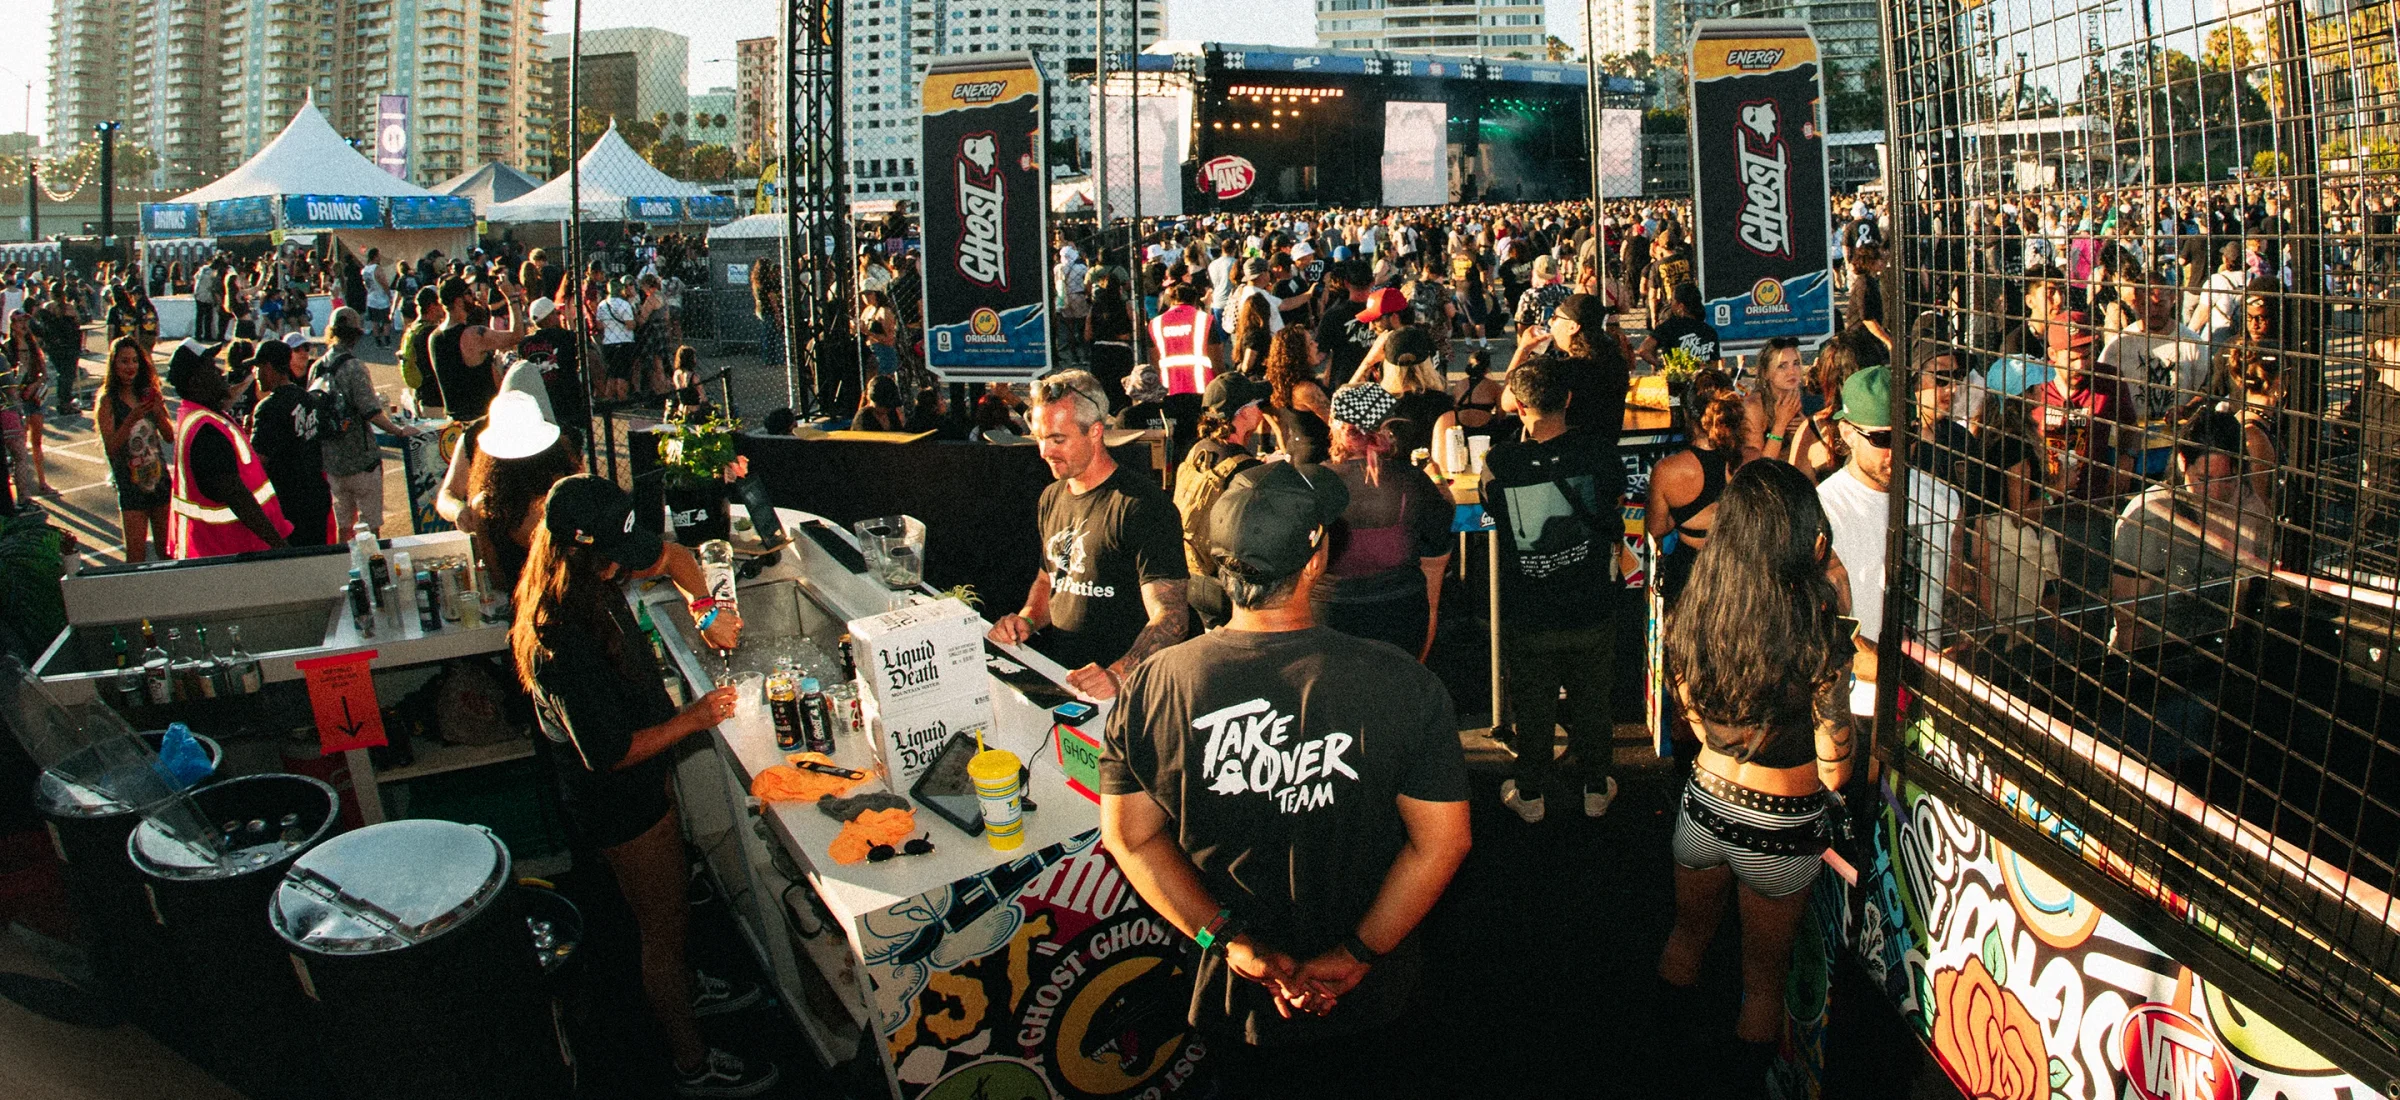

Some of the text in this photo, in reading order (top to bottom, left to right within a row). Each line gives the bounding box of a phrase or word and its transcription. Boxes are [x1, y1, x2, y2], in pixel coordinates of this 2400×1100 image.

[1727, 49, 1784, 66] ENERGY
[952, 81, 1007, 99] ENERGY
[1204, 160, 1248, 193] VANS
[1738, 128, 1791, 257] GHOST
[154, 210, 187, 230] DRINKS
[307, 202, 363, 221] DRINKS
[640, 201, 673, 216] DRINKS
[959, 159, 1007, 287] GHOST
[1745, 305, 1790, 315] ORIGINAL
[964, 334, 1007, 343] ORIGINAL
[1679, 333, 1701, 352] TAKE
[1691, 341, 1715, 357] OVER
[879, 639, 936, 671] Liquid
[888, 661, 940, 691] Death
[891, 682, 940, 698] MOUNTAIN WATER
[891, 719, 947, 751] Liquid
[1191, 698, 1294, 779] TAKE
[1250, 732, 1360, 801] OVER
[1275, 782, 1334, 814] TEAM
[1017, 950, 1087, 1047] GHOST
[2138, 1011, 2215, 1100] VANS
